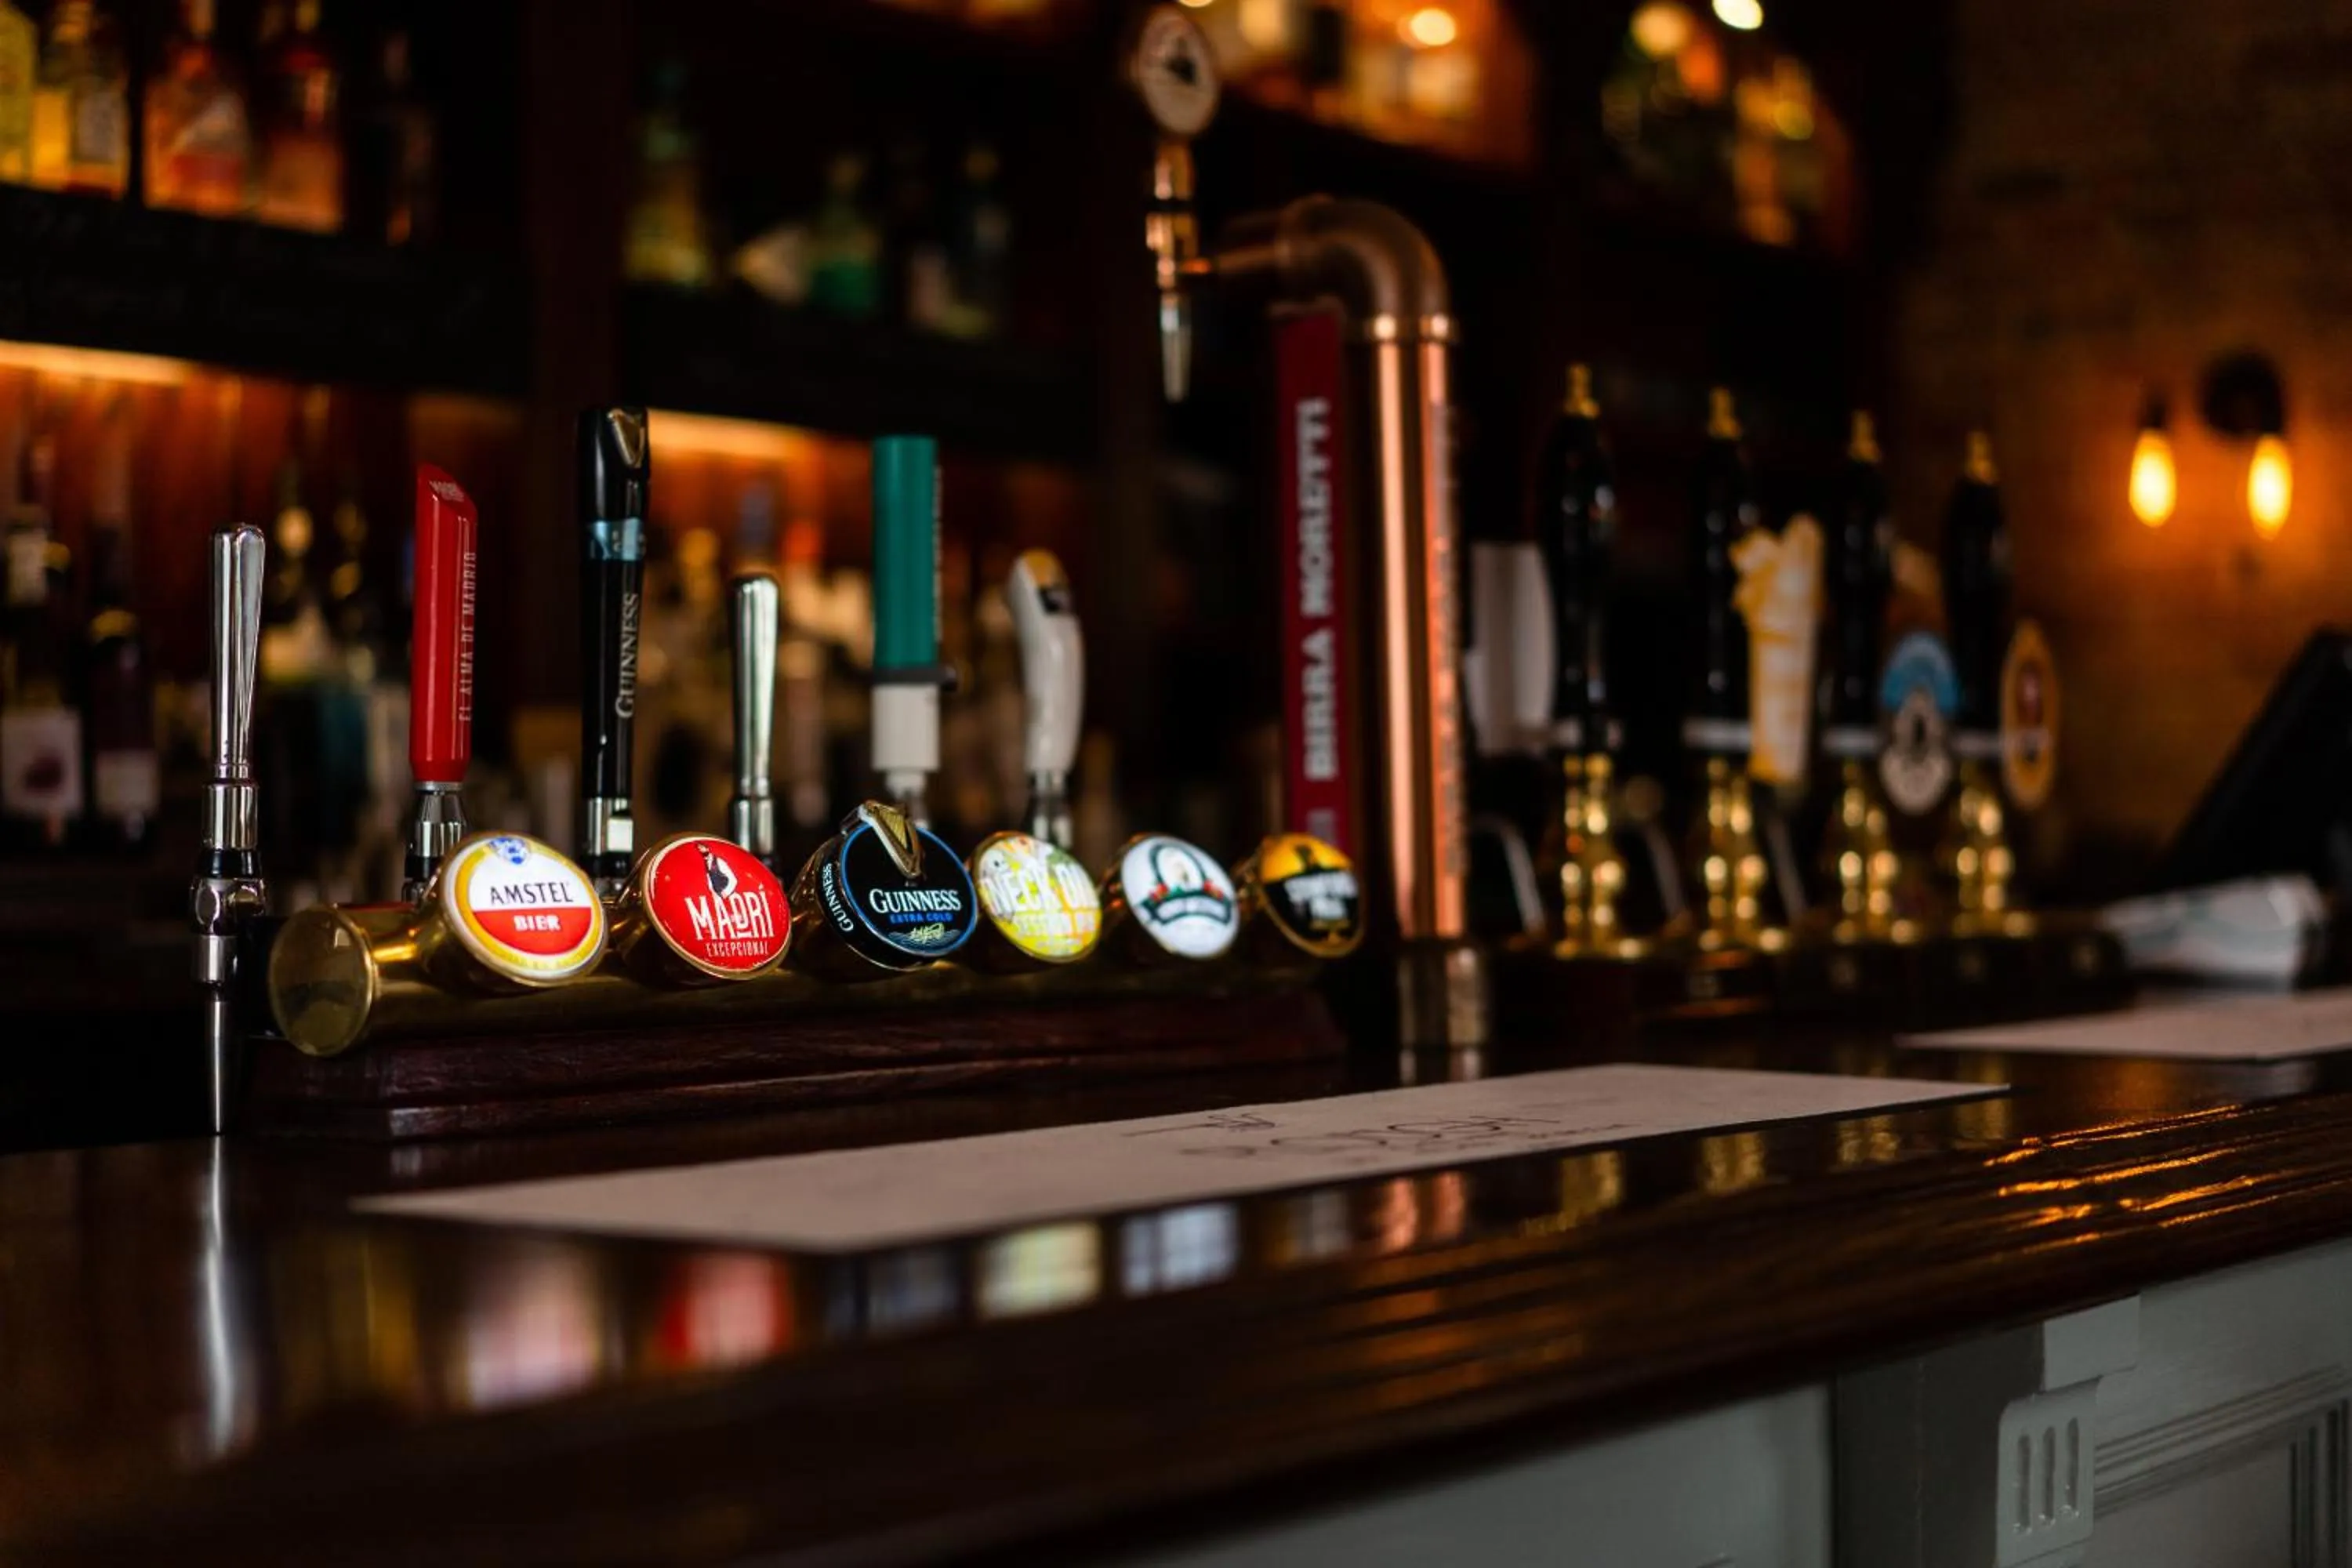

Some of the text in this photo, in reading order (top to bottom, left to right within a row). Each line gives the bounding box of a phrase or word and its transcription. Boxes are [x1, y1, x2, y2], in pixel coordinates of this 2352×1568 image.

[459, 552, 477, 722] EL ALMA DE MADRID
[615, 593, 639, 718] GUINNESS
[1301, 627, 1338, 781] BIRRA
[490, 882, 574, 905] AMSTEL
[823, 862, 855, 932] GUINNESS
[869, 887, 962, 913] GUINNESS
[981, 865, 1060, 916] NECK
[514, 914, 561, 932] BIER
[890, 912, 953, 924] EXTRA COLD
[706, 940, 769, 957] EXCEPCIONAL
